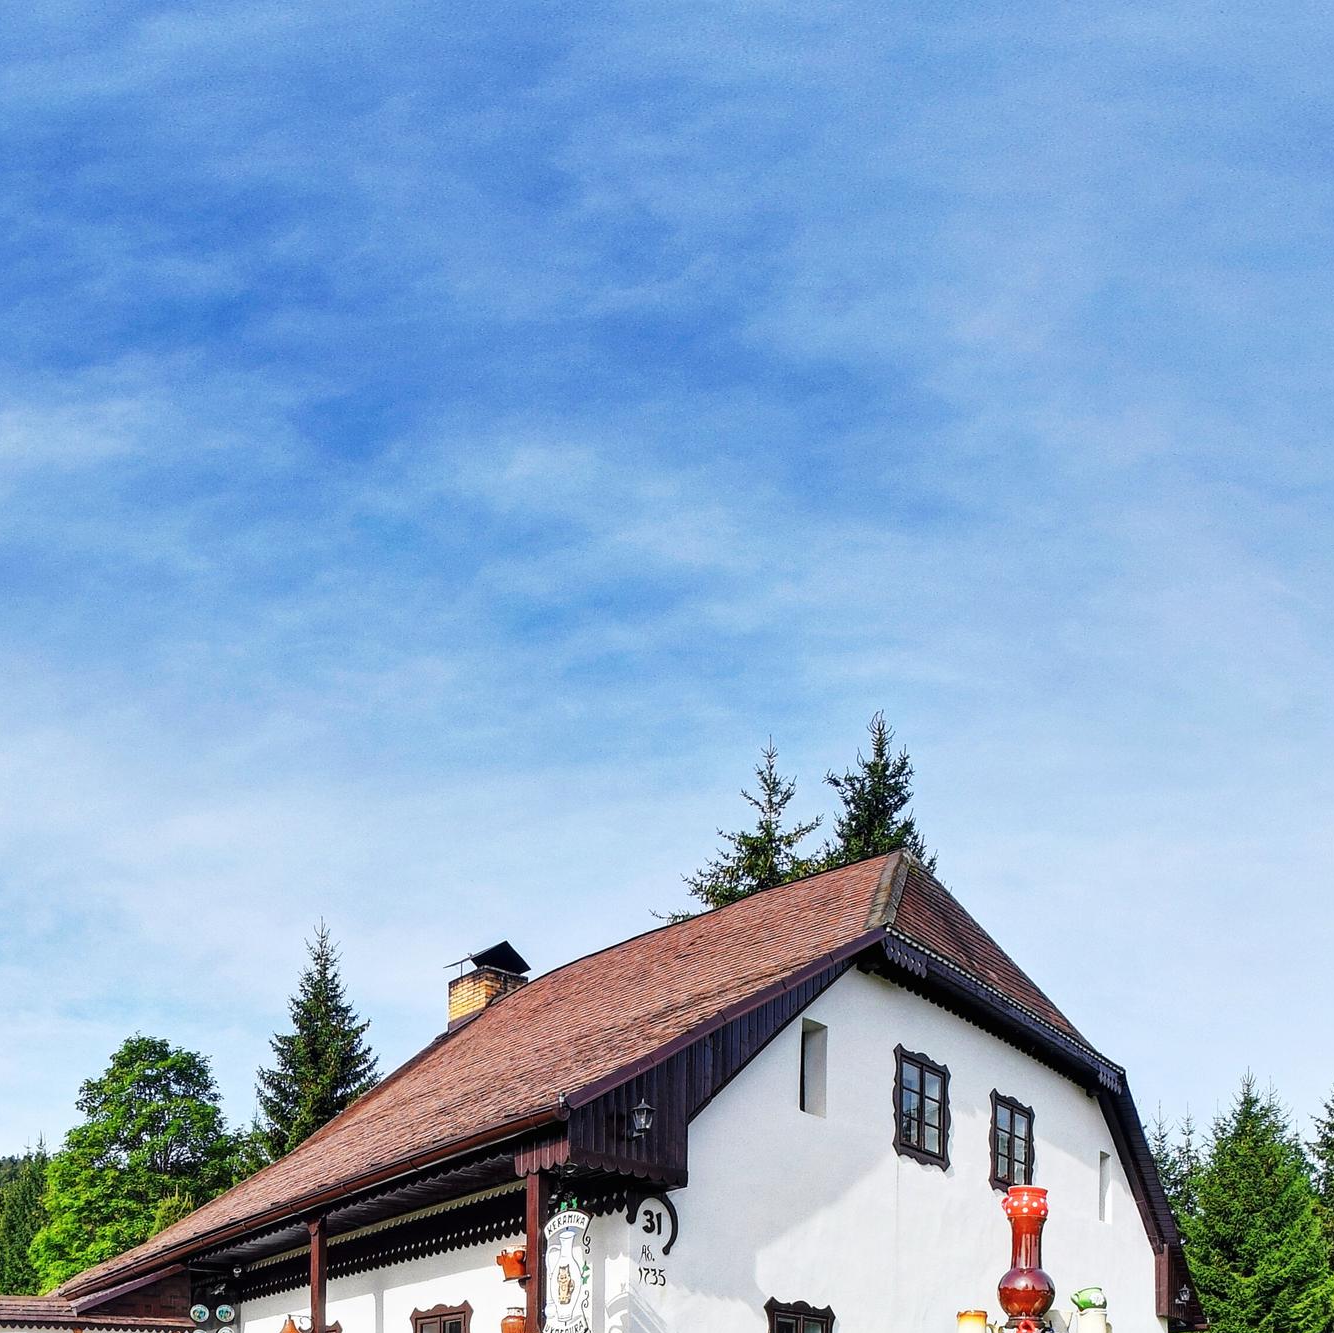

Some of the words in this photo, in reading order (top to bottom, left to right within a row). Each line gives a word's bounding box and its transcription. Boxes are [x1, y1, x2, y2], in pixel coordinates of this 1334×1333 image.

[547, 1214, 586, 1235] KERAMIKA
[642, 1210, 662, 1235] 31
[638, 1267, 666, 1286] 1735
